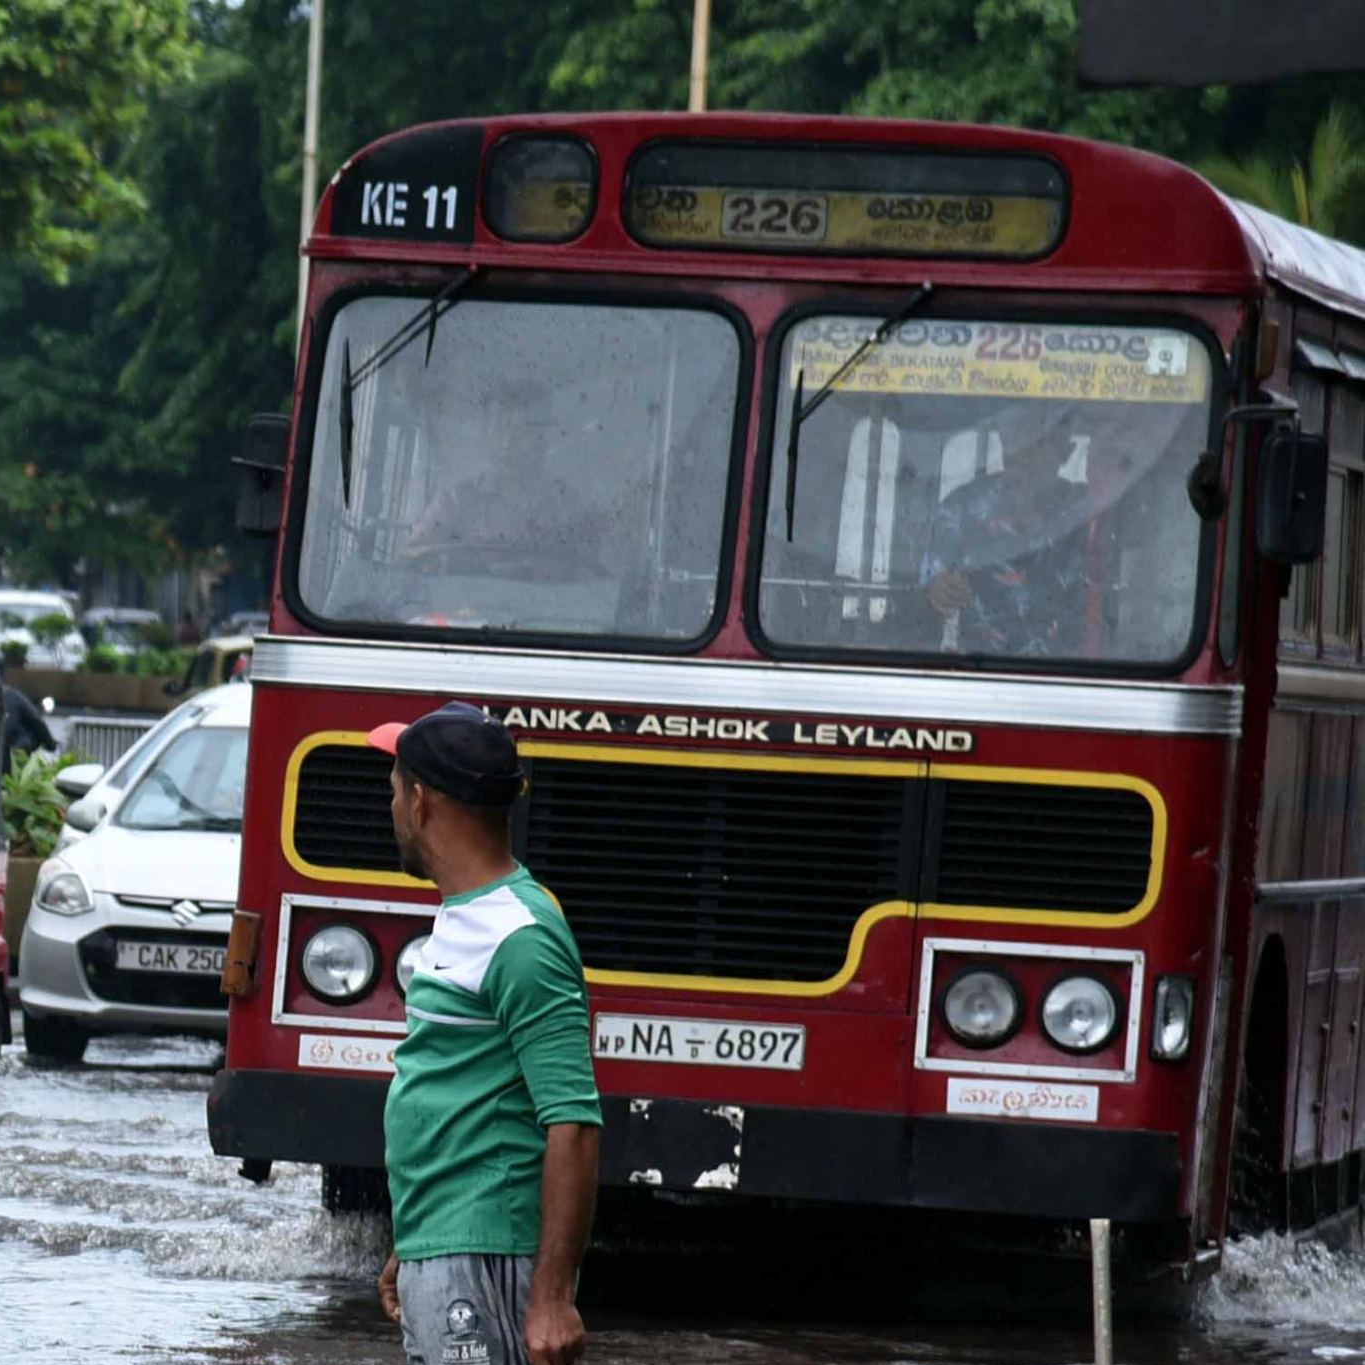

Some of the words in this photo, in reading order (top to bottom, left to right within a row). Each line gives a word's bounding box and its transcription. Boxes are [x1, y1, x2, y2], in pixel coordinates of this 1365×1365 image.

[361, 182, 409, 226] KE
[422, 185, 458, 229] 11
[729, 197, 820, 235] 226
[975, 325, 1043, 361] 226
[1044, 333, 1151, 362] කොළ
[636, 714, 769, 741] ASHOK
[794, 722, 973, 751] LEYLAND
[138, 945, 178, 969] CAK
[186, 949, 226, 972] 250
[631, 1023, 673, 1056] NA
[716, 1029, 800, 1063] 6897
